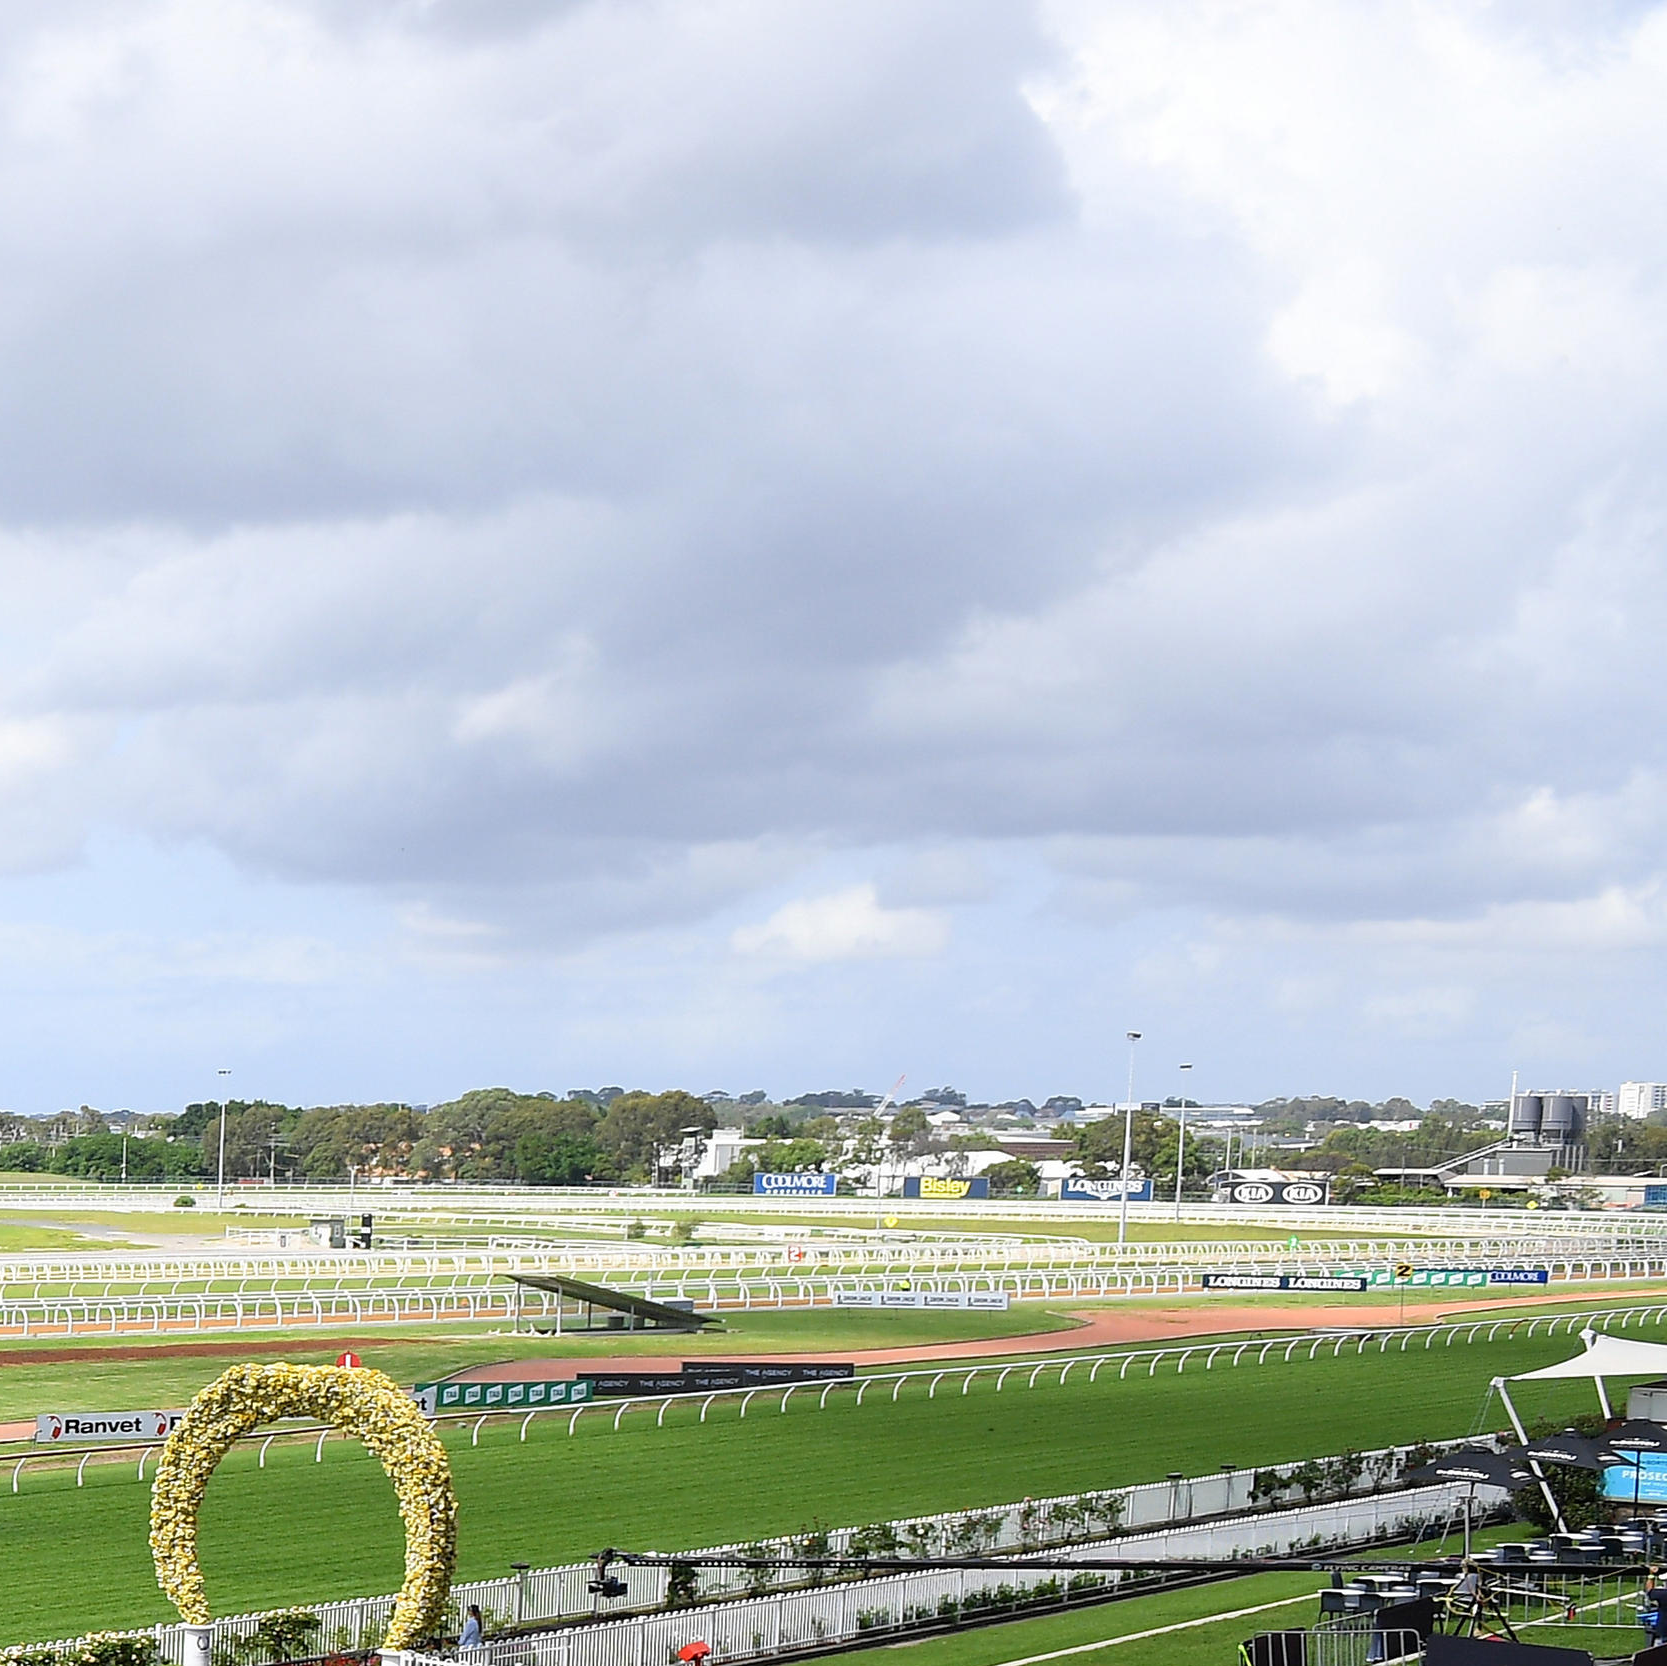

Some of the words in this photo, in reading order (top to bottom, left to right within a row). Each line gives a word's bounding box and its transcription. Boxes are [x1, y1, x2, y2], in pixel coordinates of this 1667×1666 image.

[761, 1174, 827, 1189] COOLMORE
[920, 1177, 971, 1196] Bisley
[1067, 1179, 1144, 1194] LONGINES
[1240, 1186, 1266, 1201] KIA
[1289, 1186, 1317, 1201] KIA
[1397, 1265, 1411, 1277] 2
[1209, 1276, 1281, 1288] LONGINES
[1288, 1277, 1361, 1291] LONGINES
[65, 1416, 143, 1436] Ranvet
[1361, 1564, 1412, 1572] CAMERAS
